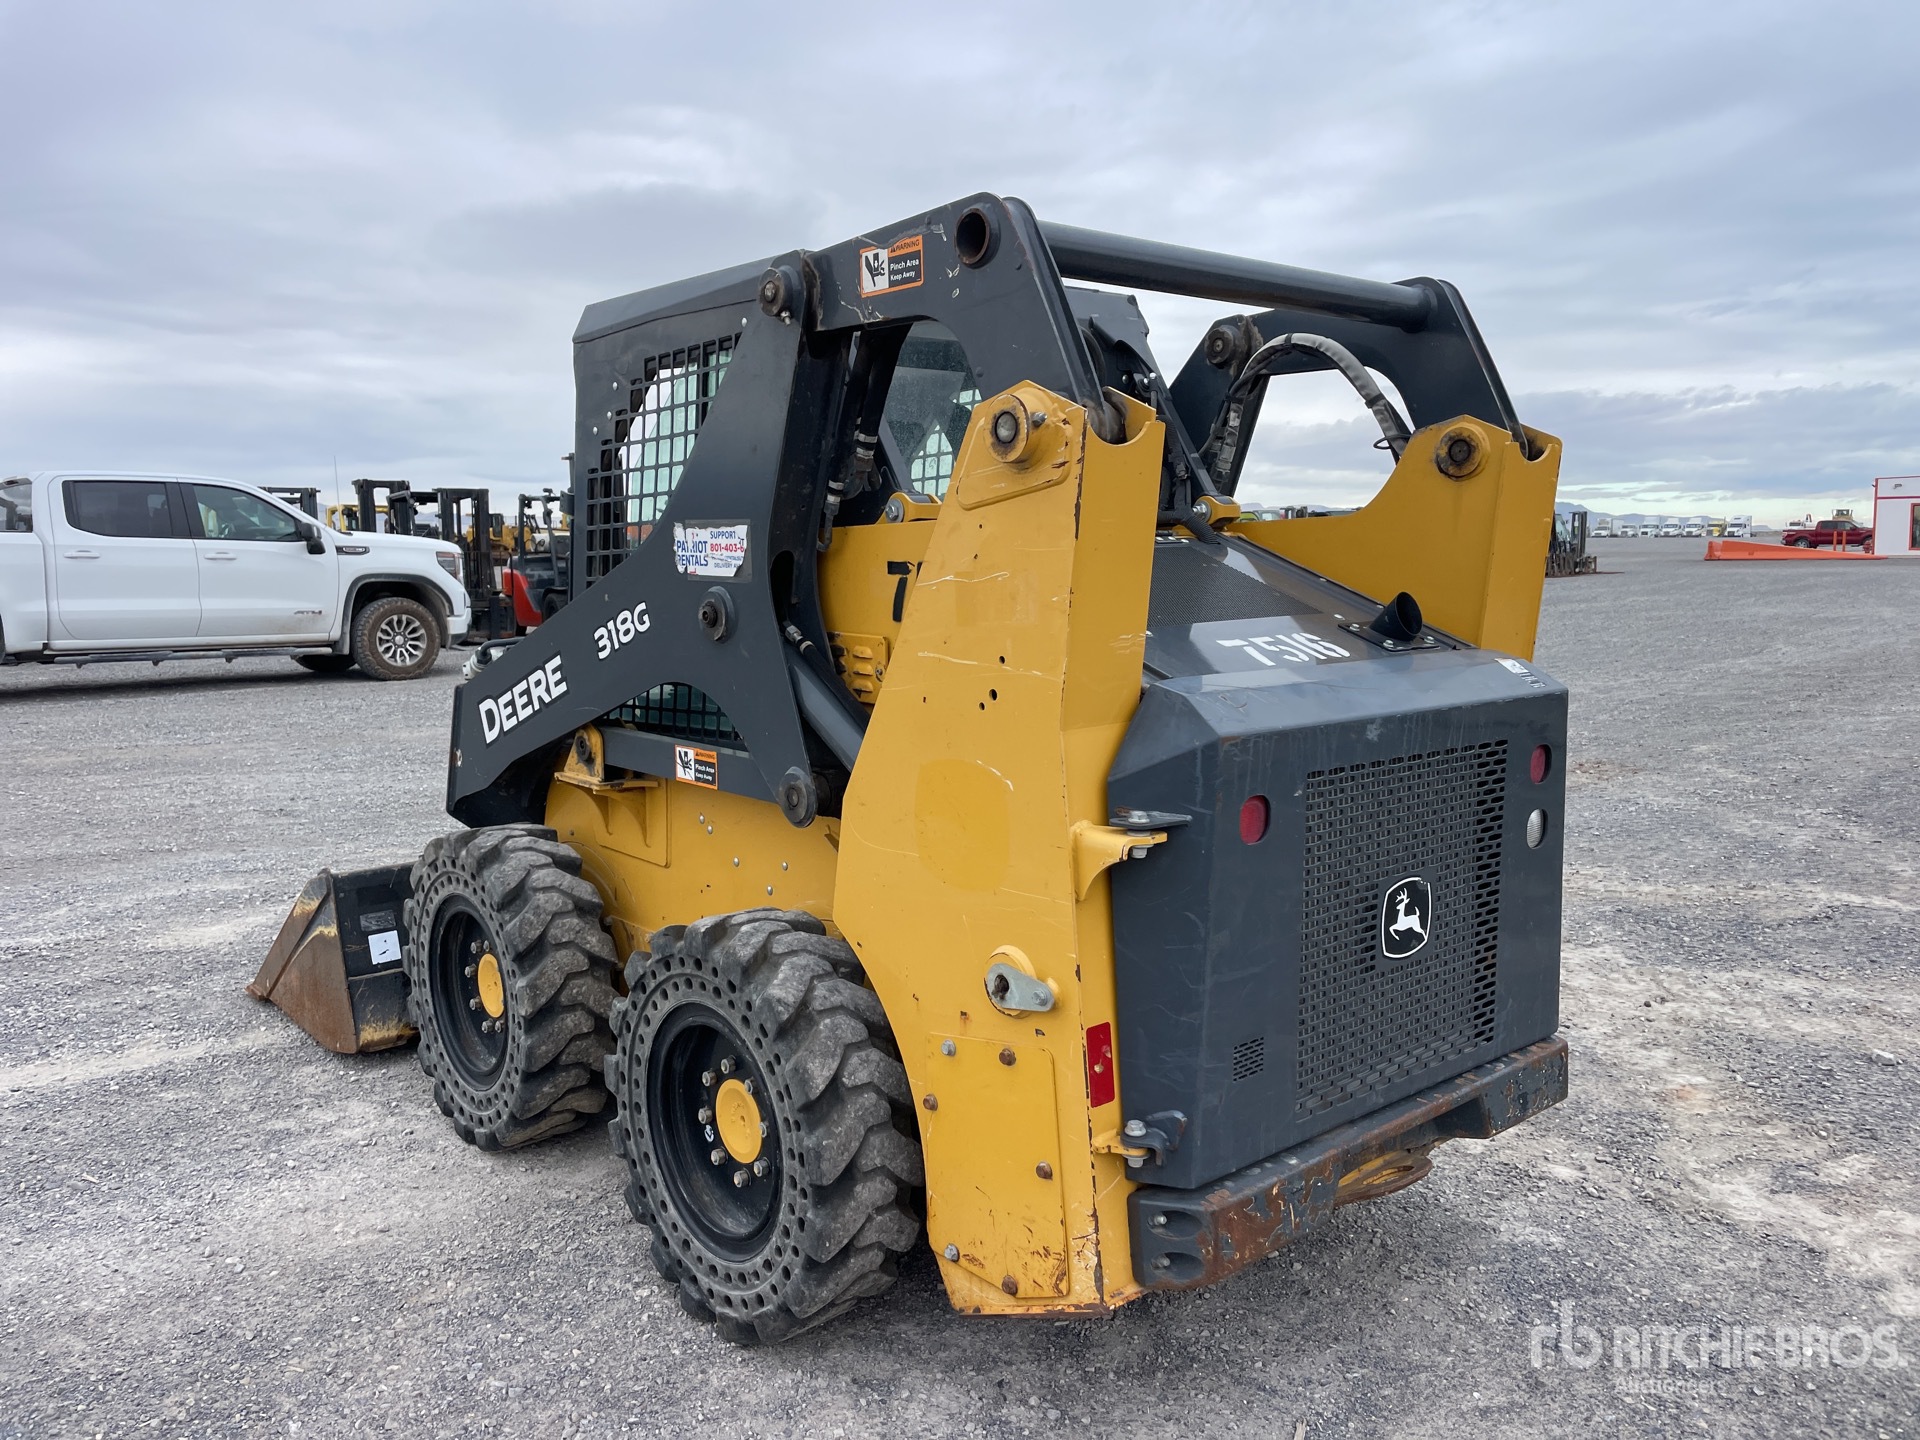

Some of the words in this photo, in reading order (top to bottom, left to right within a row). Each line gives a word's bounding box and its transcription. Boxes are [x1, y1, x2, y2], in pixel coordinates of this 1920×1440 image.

[895, 239, 920, 252] WARNING
[890, 260, 906, 271] Pinch
[906, 258, 920, 268] Area
[890, 273, 902, 281] Keep
[903, 270, 916, 278] Away
[709, 530, 737, 540] SUPPORT
[593, 602, 651, 659] 318G
[1216, 632, 1351, 667] 7516
[478, 654, 568, 744] DEERE
[695, 763, 706, 771] Pinch
